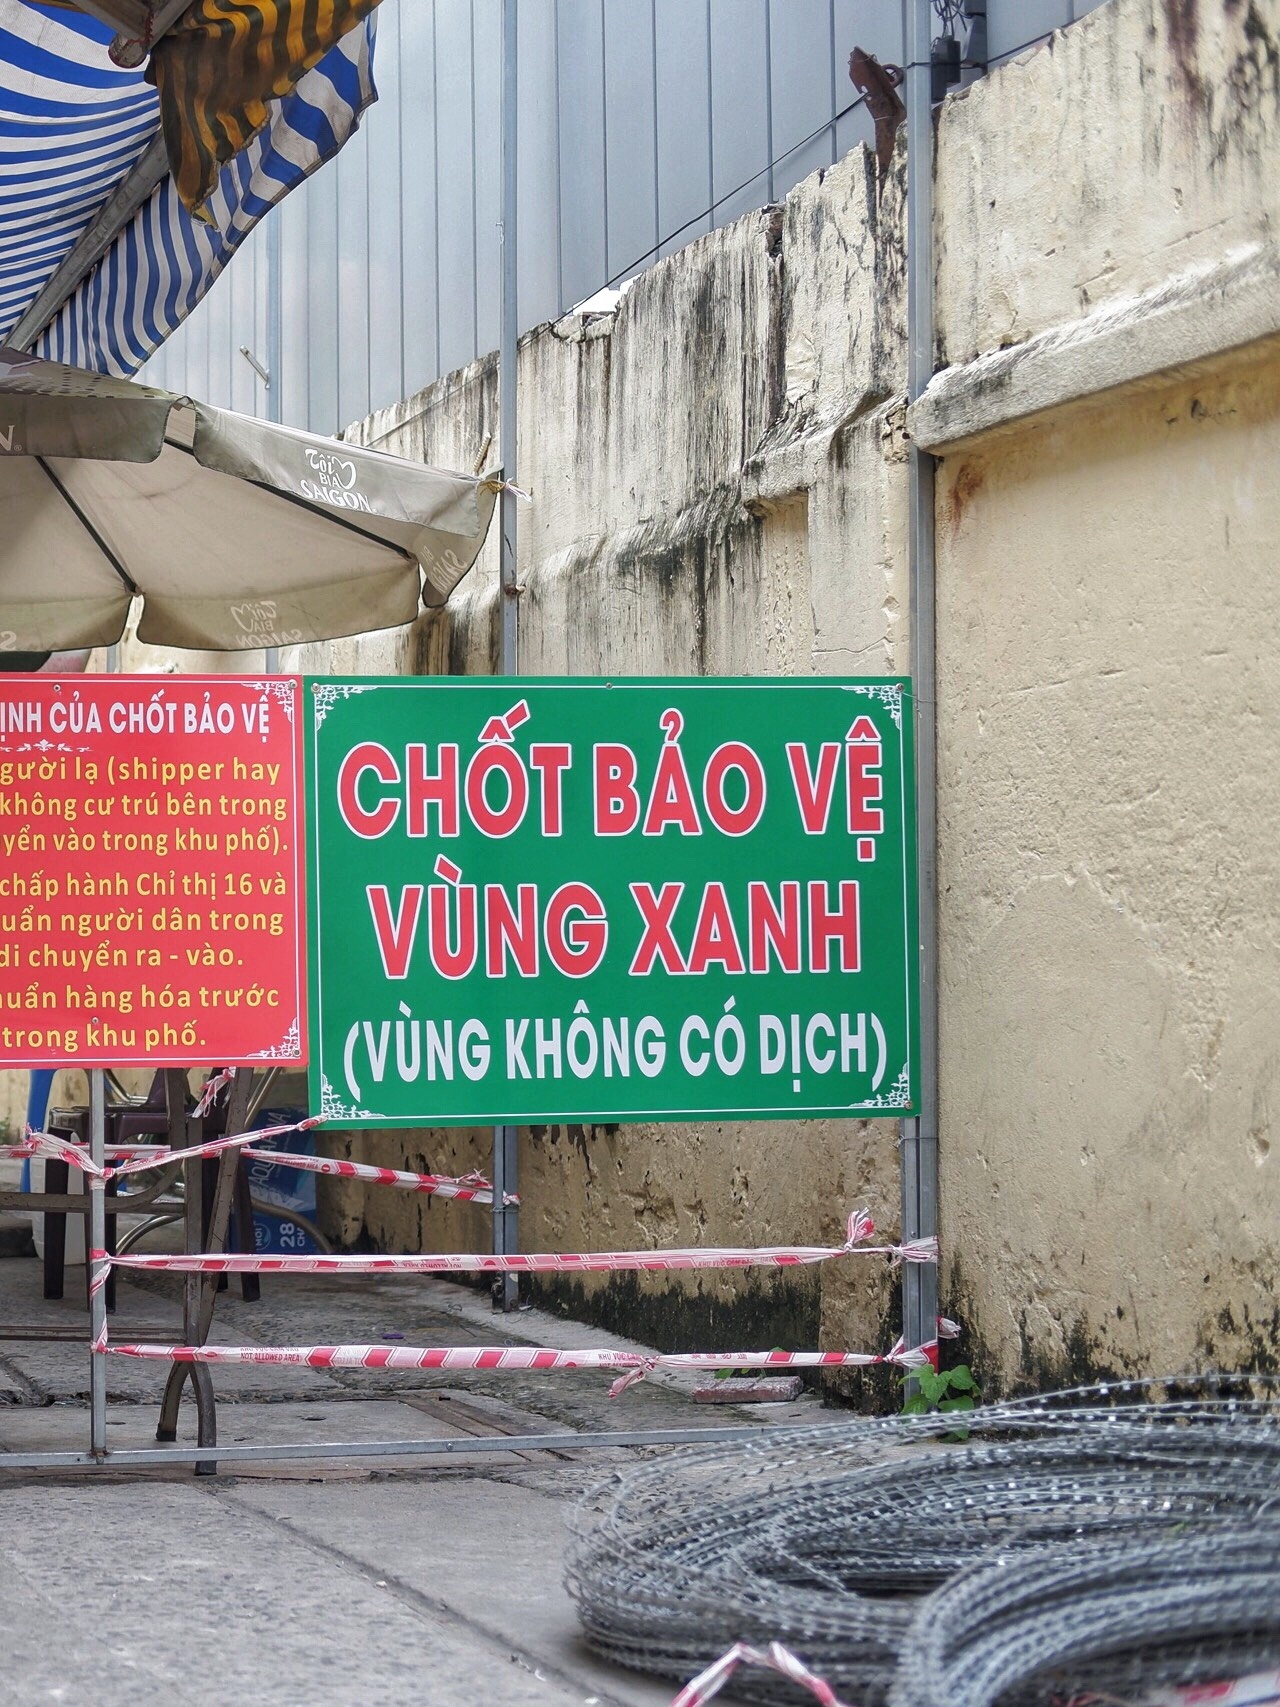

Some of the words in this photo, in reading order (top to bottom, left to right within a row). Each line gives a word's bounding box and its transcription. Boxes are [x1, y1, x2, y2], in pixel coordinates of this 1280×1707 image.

[300, 479, 374, 514] SAIGON
[319, 472, 342, 489] BIA
[50, 691, 102, 733] CỦA
[109, 689, 177, 733] CHỐT
[184, 692, 234, 734] BẢO
[241, 695, 269, 743] VỆ
[75, 756, 98, 785] lạ
[107, 755, 225, 786] (shipper
[233, 756, 281, 786] hay
[337, 699, 572, 840] CHỐT
[593, 708, 767, 838] BẢO
[785, 716, 884, 862] VỆ
[0, 791, 77, 822] không
[84, 796, 115, 816] cư
[121, 791, 159, 816] trú
[166, 791, 212, 816] bên
[218, 794, 288, 822] trong
[52, 826, 96, 851] vào
[101, 830, 169, 857] trong
[175, 826, 218, 851] khu
[225, 824, 288, 857] phố).
[66, 871, 129, 896] hành
[136, 869, 176, 896] Chỉ
[181, 871, 217, 901] thị
[224, 872, 253, 896] 16
[259, 871, 287, 896] và
[61, 907, 143, 937] người
[151, 906, 201, 931] dân
[208, 909, 284, 936] trong
[366, 853, 609, 980] VÙNG
[629, 880, 861, 976] XANH
[28, 939, 128, 973] chuyển
[136, 948, 161, 967] ra
[185, 942, 243, 966] vào.
[66, 984, 133, 1014] hàng
[141, 983, 191, 1008] hóa
[198, 982, 279, 1008] trước
[1, 1026, 79, 1053] trong
[86, 1023, 136, 1047] khu
[145, 1020, 206, 1052] phố.
[344, 1001, 491, 1103] (VÙNG
[506, 1000, 666, 1081] KHÔNG
[680, 995, 745, 1077] CÓ
[760, 1011, 887, 1093] DỊCH)
[279, 1222, 296, 1248] 28
[254, 1353, 282, 1362] ALLOWED
[284, 1354, 300, 1362] AREA
